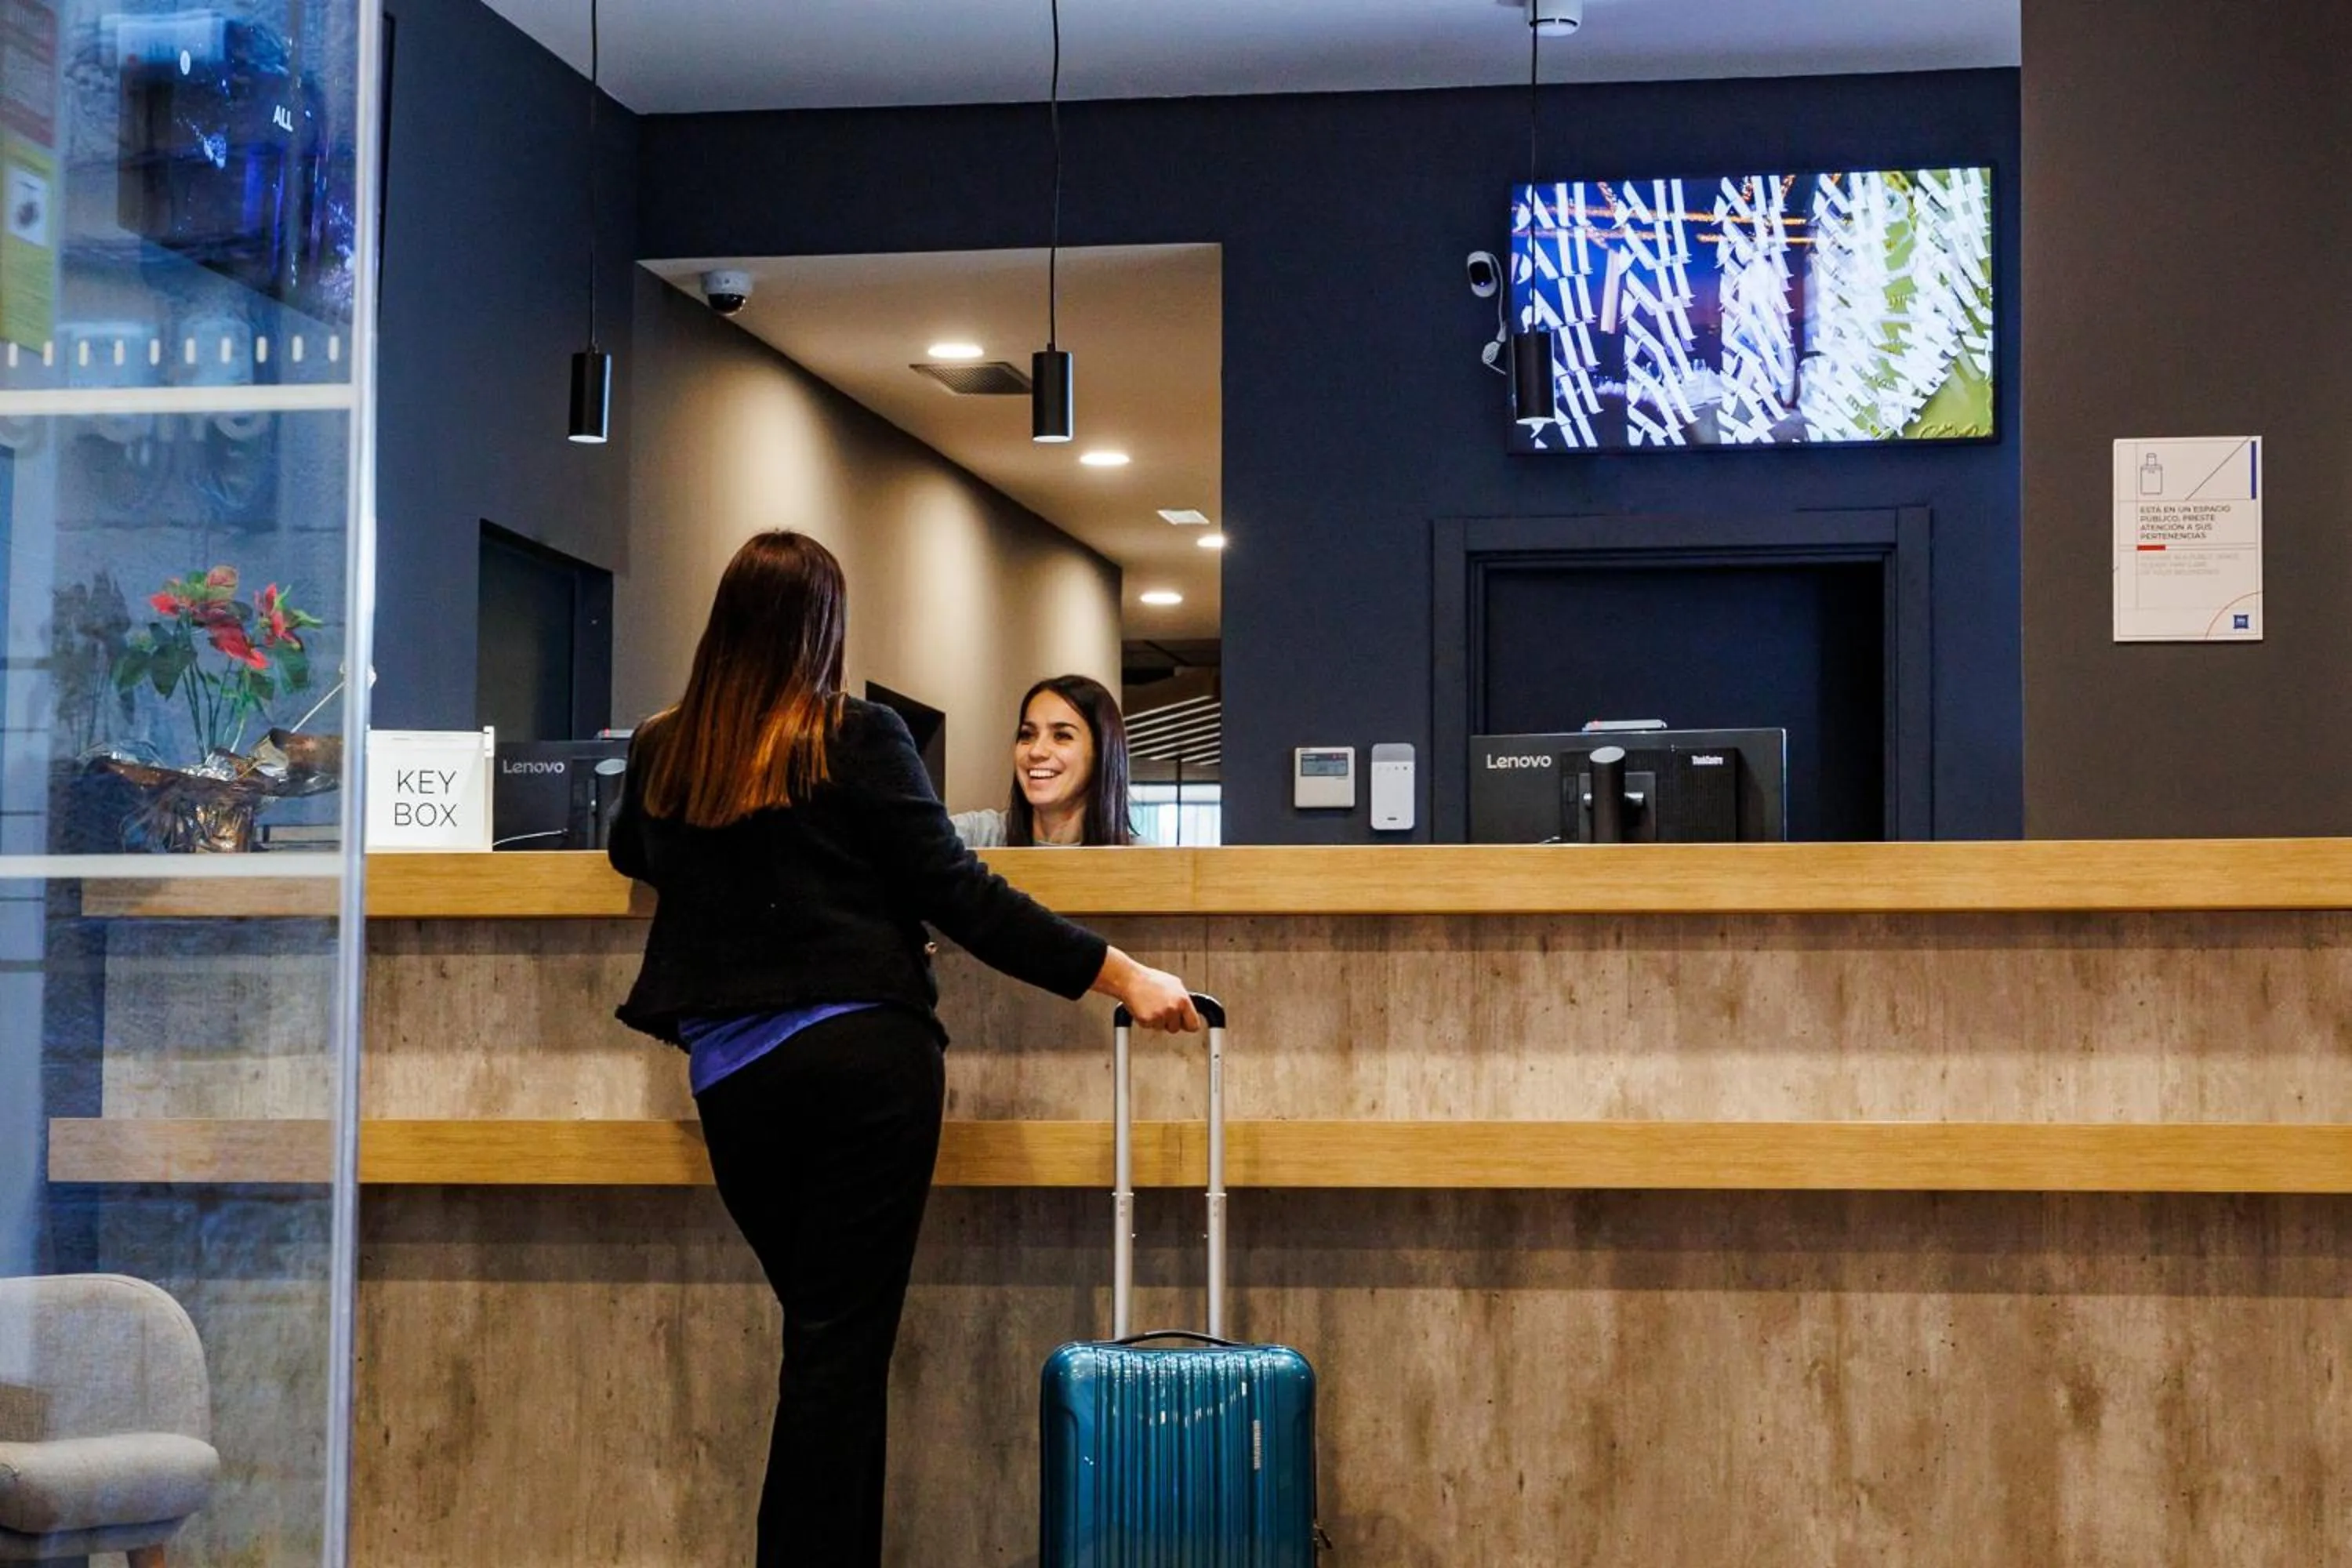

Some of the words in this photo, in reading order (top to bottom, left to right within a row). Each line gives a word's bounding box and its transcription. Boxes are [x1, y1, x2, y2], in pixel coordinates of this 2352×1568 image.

[2194, 504, 2231, 514] ESPACIO
[2195, 522, 2212, 531] SUS
[503, 759, 565, 775] Lenovo
[1486, 753, 1552, 770] Lenovo
[397, 770, 457, 794] KEY
[394, 802, 458, 828] BOX
